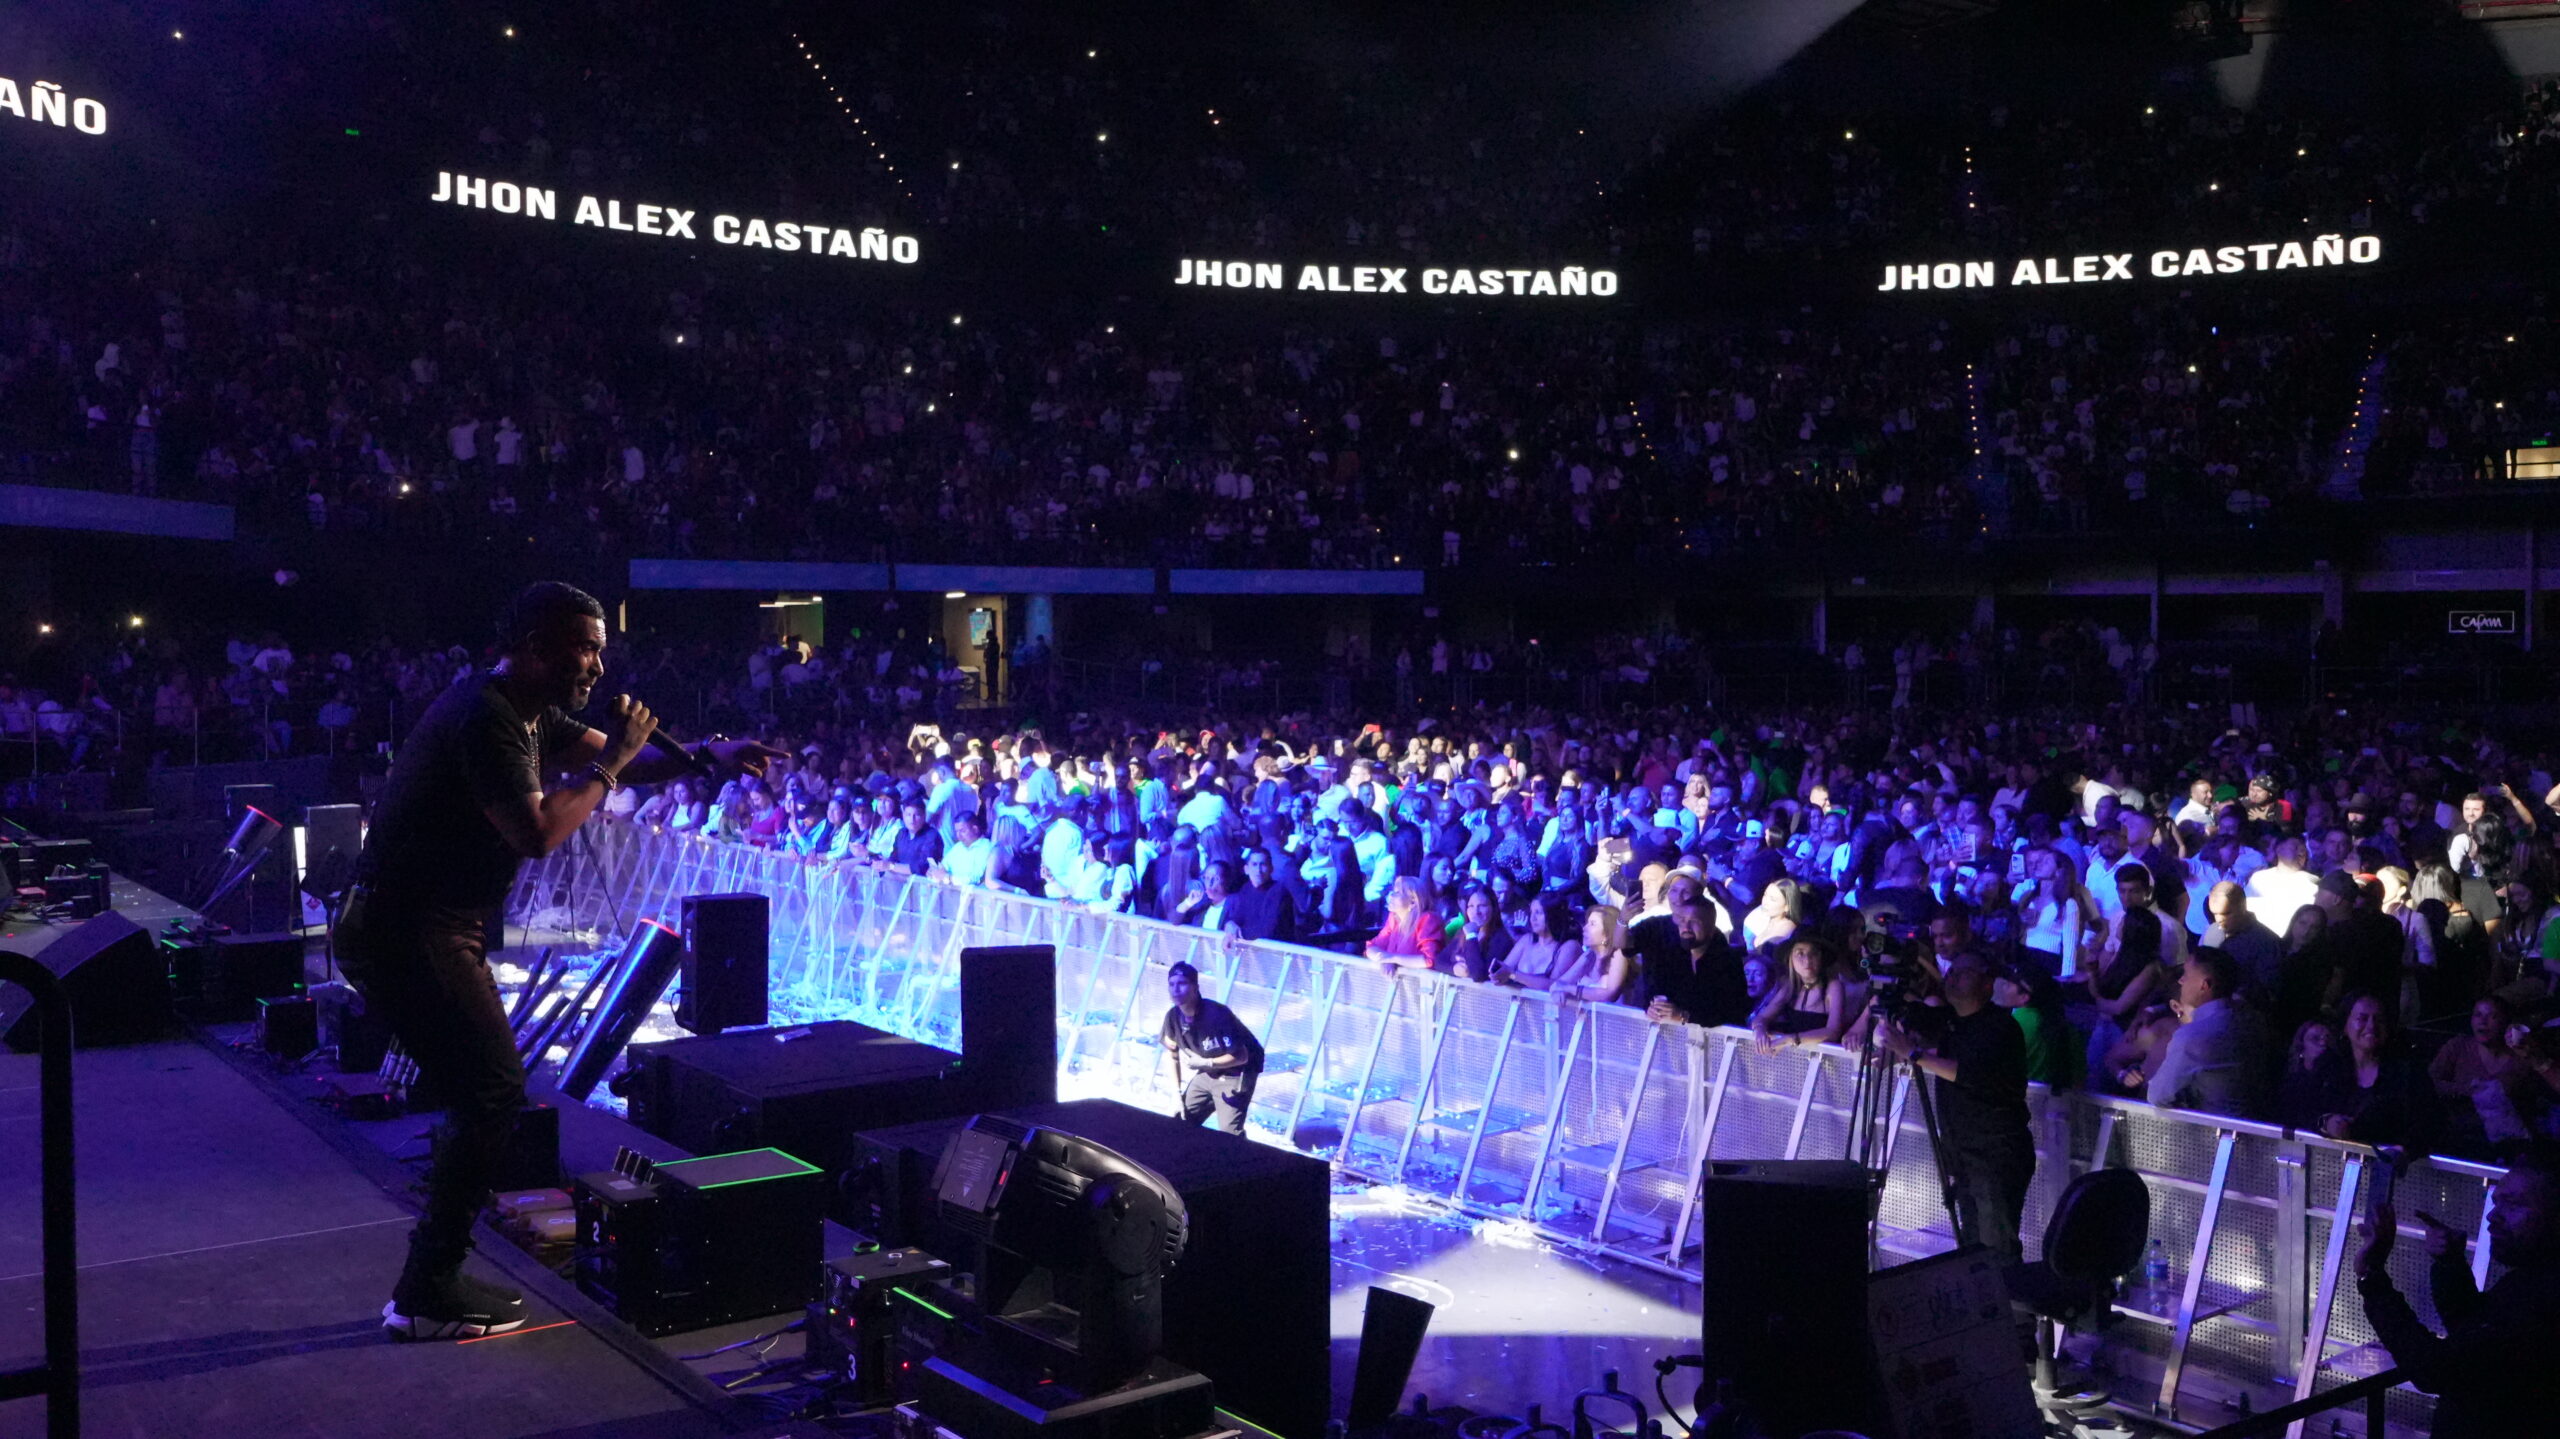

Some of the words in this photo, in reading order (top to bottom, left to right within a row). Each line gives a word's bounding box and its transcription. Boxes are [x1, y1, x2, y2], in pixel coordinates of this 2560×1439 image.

[430, 170, 557, 221] JHON
[573, 194, 697, 241] ALEX
[712, 213, 920, 265] CASTAÑO
[1173, 258, 1284, 291] JHON
[1296, 264, 1408, 294] ALEX
[1421, 265, 1619, 298] CASTAÑO
[1877, 261, 1995, 292] JHON
[2010, 252, 2134, 287] ALEX
[2150, 233, 2382, 279] CASTAÑO
